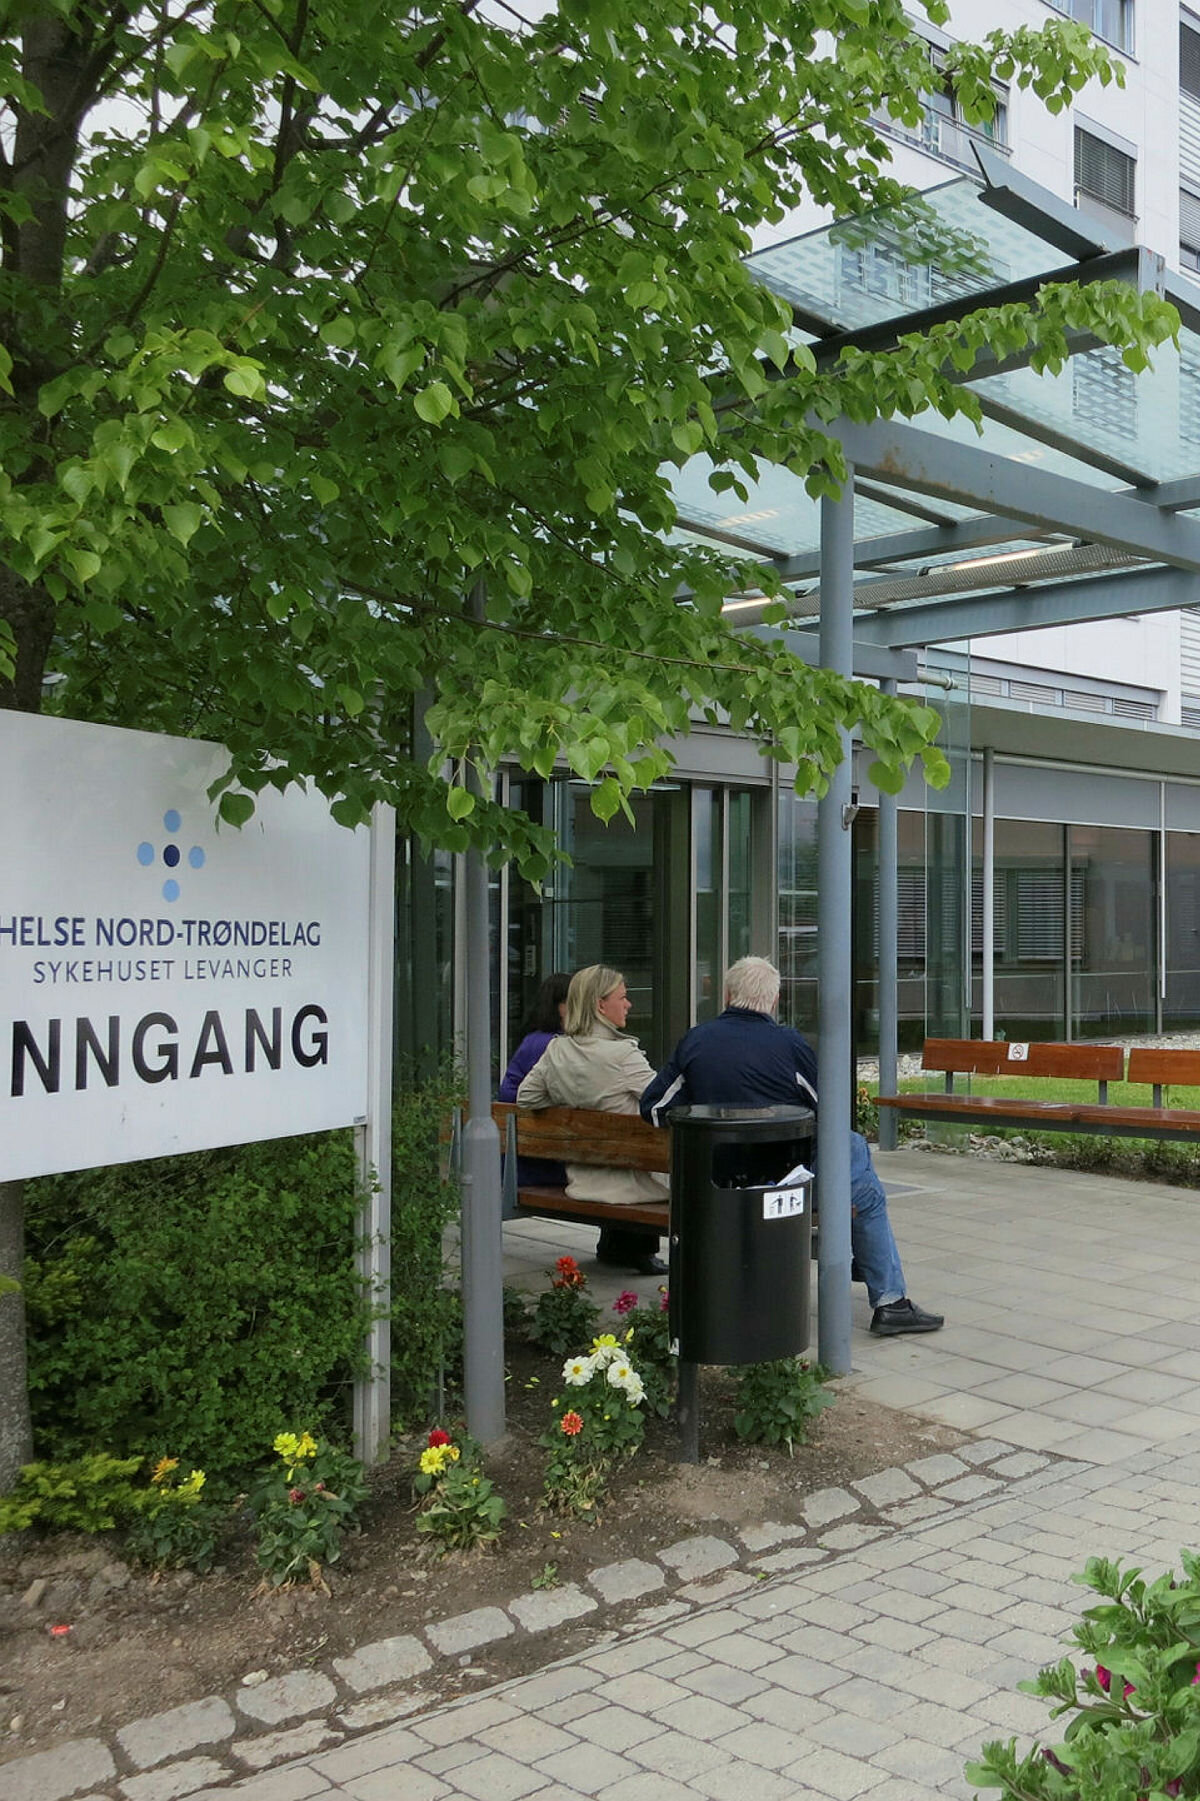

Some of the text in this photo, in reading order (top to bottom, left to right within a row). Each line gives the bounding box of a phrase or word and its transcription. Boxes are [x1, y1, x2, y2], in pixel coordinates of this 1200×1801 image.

[0, 916, 321, 946] HELSE NORD-TRØNDELAG
[32, 959, 292, 983] SYKEHUSET LEVANGER
